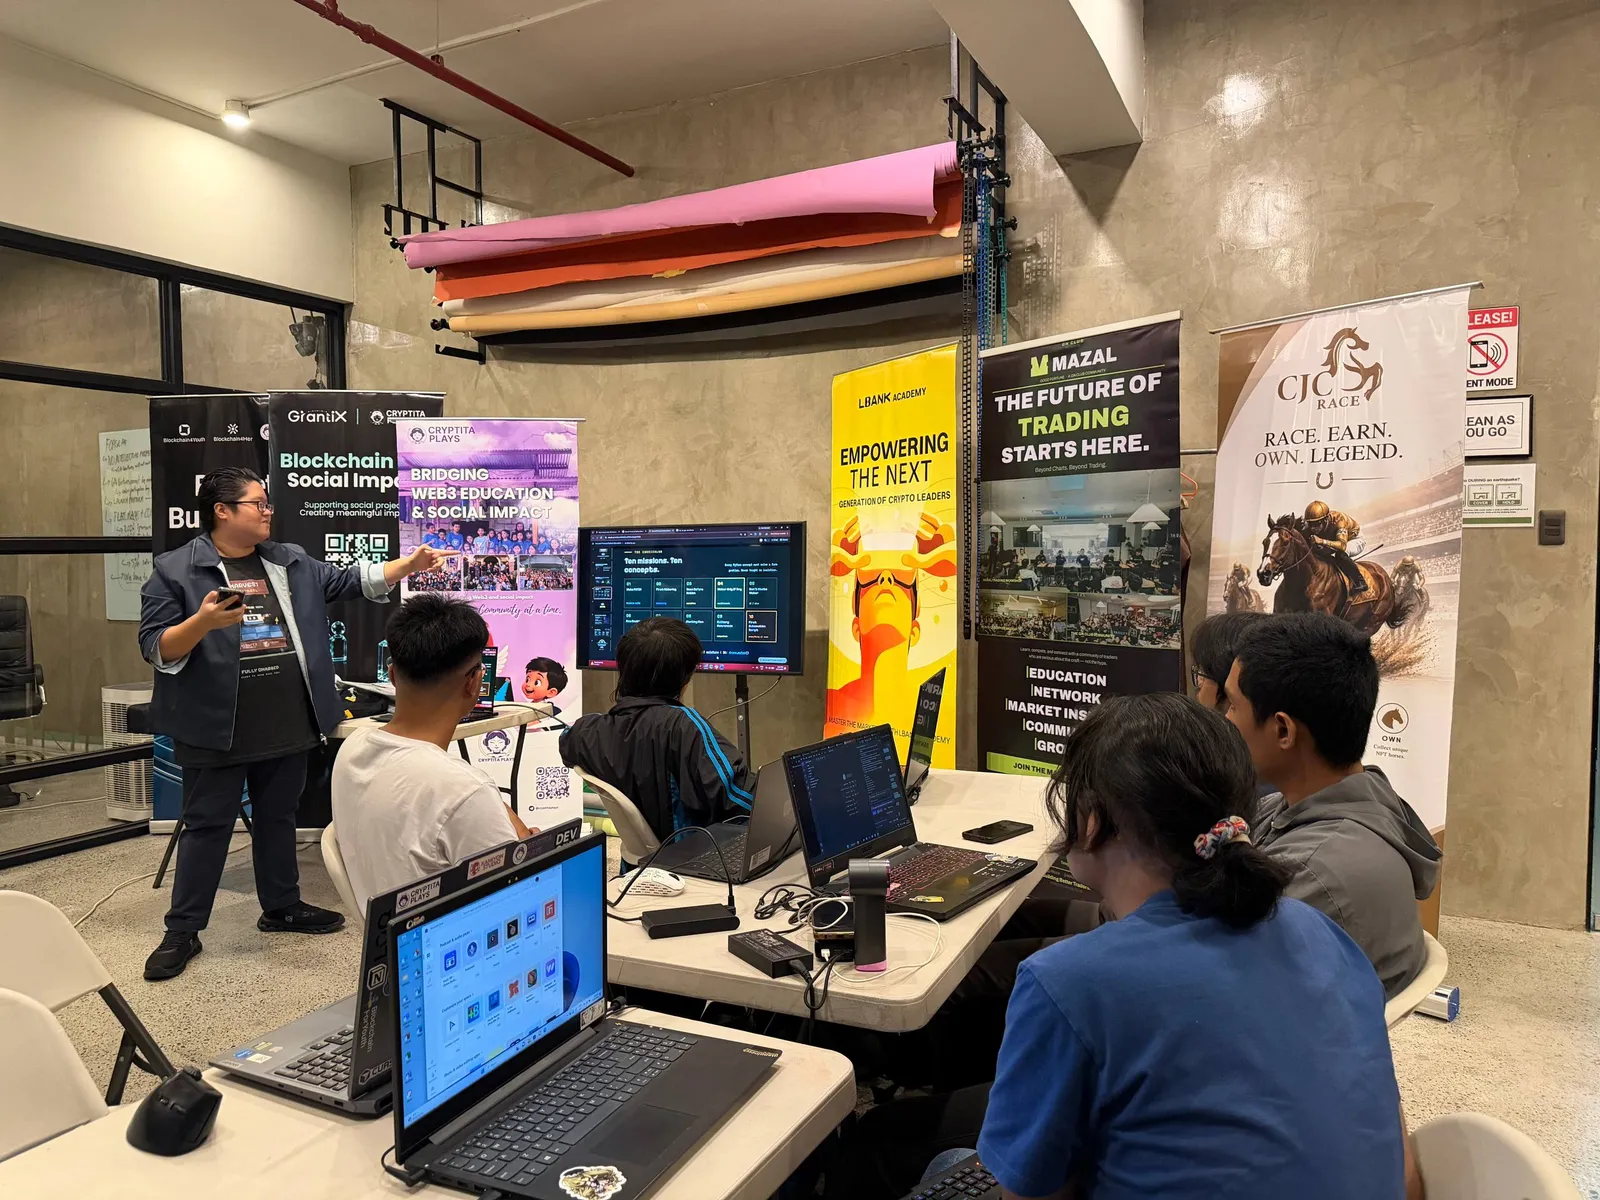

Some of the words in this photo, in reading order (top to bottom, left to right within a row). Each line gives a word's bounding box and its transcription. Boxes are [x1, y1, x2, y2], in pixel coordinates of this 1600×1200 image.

[1468, 311, 1513, 325] LEASE!
[1052, 347, 1117, 371] MAZAL
[1467, 379, 1484, 387] ENT
[1486, 378, 1513, 386] MODE
[858, 392, 891, 409] LBANK
[892, 387, 927, 402] ACADEMY
[995, 392, 1033, 412] THE
[1037, 377, 1125, 407] FUTURE
[1129, 372, 1162, 394] OF
[1317, 395, 1360, 410] RACE
[1018, 405, 1129, 437] TRADING
[1465, 416, 1493, 426] EAN
[1497, 415, 1515, 425] AS
[429, 435, 460, 443] PLAYS
[1264, 427, 1320, 447] RACE.
[1327, 422, 1392, 442] EARN.
[1466, 428, 1484, 437] OU
[1488, 427, 1507, 437] GO
[840, 432, 949, 466] EMPOWERING
[1001, 439, 1076, 464] STARTS
[1082, 434, 1149, 456] HERE.
[1255, 449, 1304, 467] OWN.
[1310, 443, 1403, 464] LEGEND.
[280, 452, 393, 469] Blockchain
[1035, 465, 1052, 473] Beyond
[1069, 463, 1088, 471] Beyond
[287, 471, 348, 488] Social
[411, 468, 489, 481] BRIDGING
[850, 466, 880, 489] THE
[886, 460, 932, 486] NEXT
[411, 487, 457, 500] WEB3
[460, 487, 553, 500] EDUCATION
[839, 496, 876, 508] GENERATION
[877, 496, 886, 505] OF
[888, 493, 915, 504] CRYPTO
[917, 491, 951, 502] LEADERS
[299, 509, 334, 518] Creating
[336, 509, 382, 518] meaningful
[384, 509, 400, 518] imp
[304, 502, 349, 511] Supporting
[412, 506, 424, 519] &
[427, 506, 486, 519] SOCIAL
[489, 506, 552, 519] IMPACT
[169, 507, 199, 529] Bu
[624, 566, 660, 574] concepts.
[479, 604, 521, 618] Community
[524, 605, 534, 614] at
[1030, 667, 1106, 686] EDUCATION
[1034, 686, 1101, 705] NETWORK
[1008, 700, 1062, 719] MARKET
[1063, 708, 1089, 721] INS
[828, 716, 845, 726] MASTER
[846, 719, 856, 728] THE
[933, 735, 951, 744] DEMY
[1037, 739, 1066, 755] GRO
[1382, 735, 1401, 743] OWN
[1013, 762, 1030, 772] JOIN
[1031, 764, 1046, 774] THE
[556, 827, 578, 846] DEV
[410, 881, 440, 898] CRYPTITA
[410, 891, 430, 904] PLAYS
[368, 1005, 378, 1052] Blockchain
